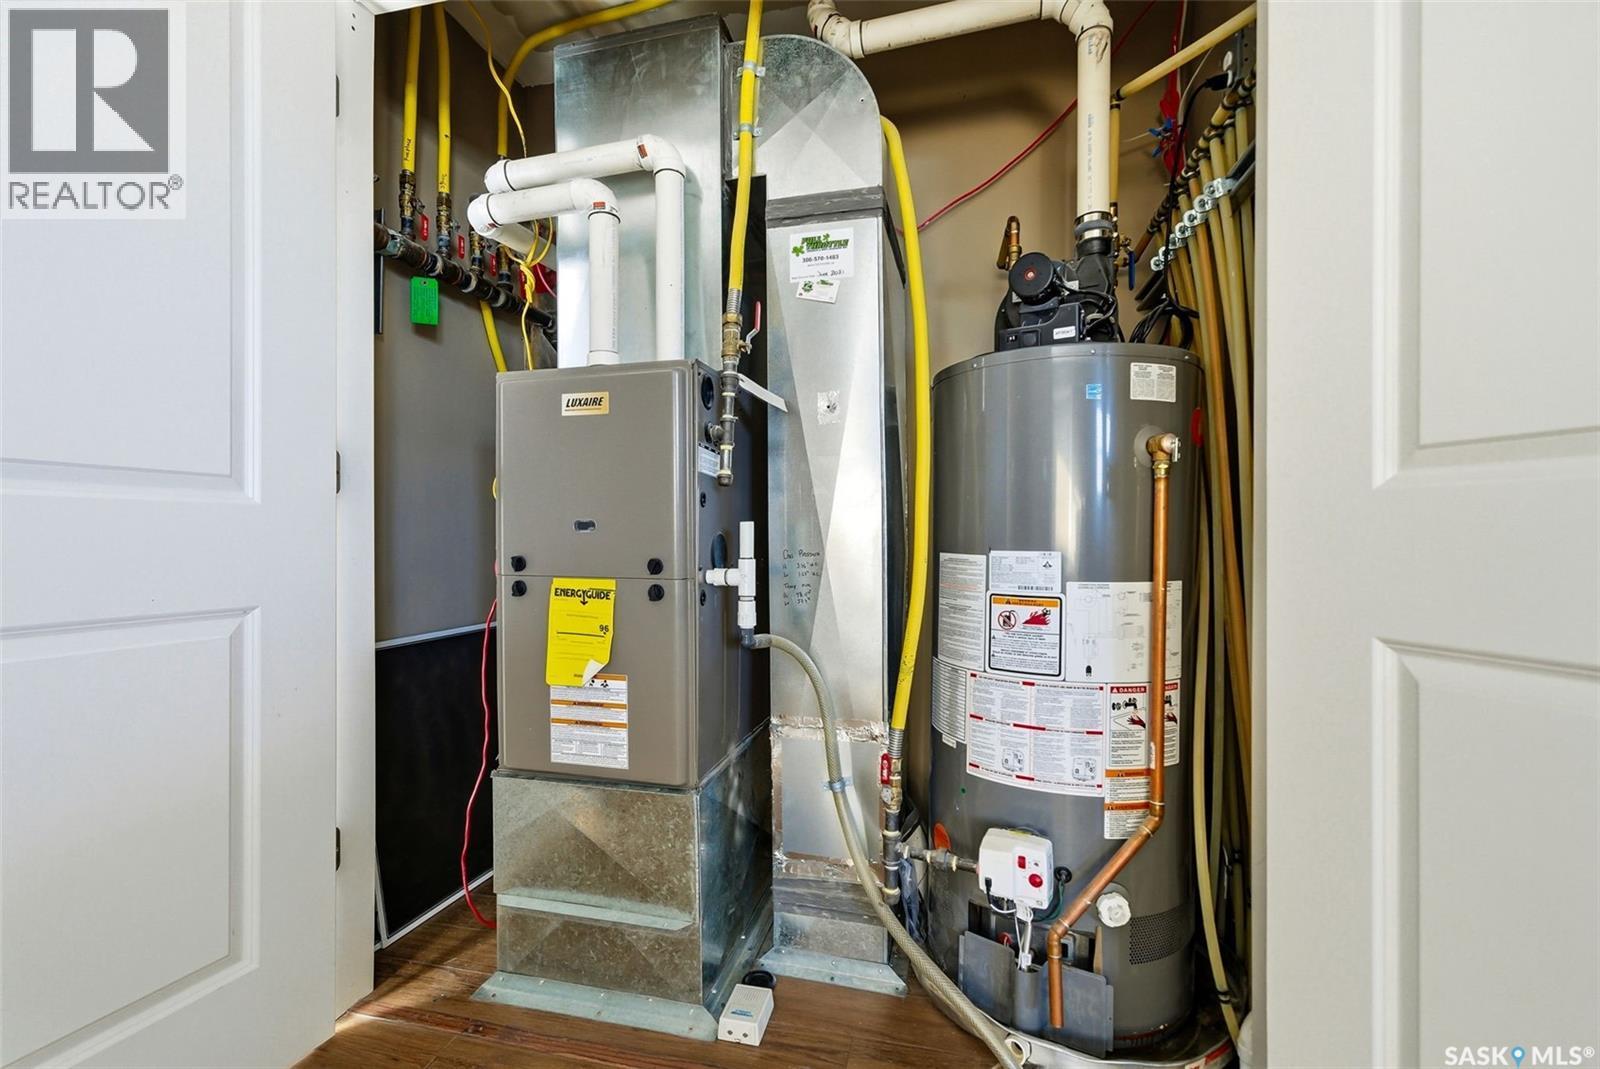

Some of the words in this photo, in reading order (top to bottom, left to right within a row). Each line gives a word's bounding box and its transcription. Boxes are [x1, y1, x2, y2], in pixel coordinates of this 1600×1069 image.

[565, 396, 605, 408] LUXAIRE
[554, 587, 611, 603] ENERGYGUIDE
[599, 624, 610, 633] 96
[1118, 686, 1147, 694] DANGER
